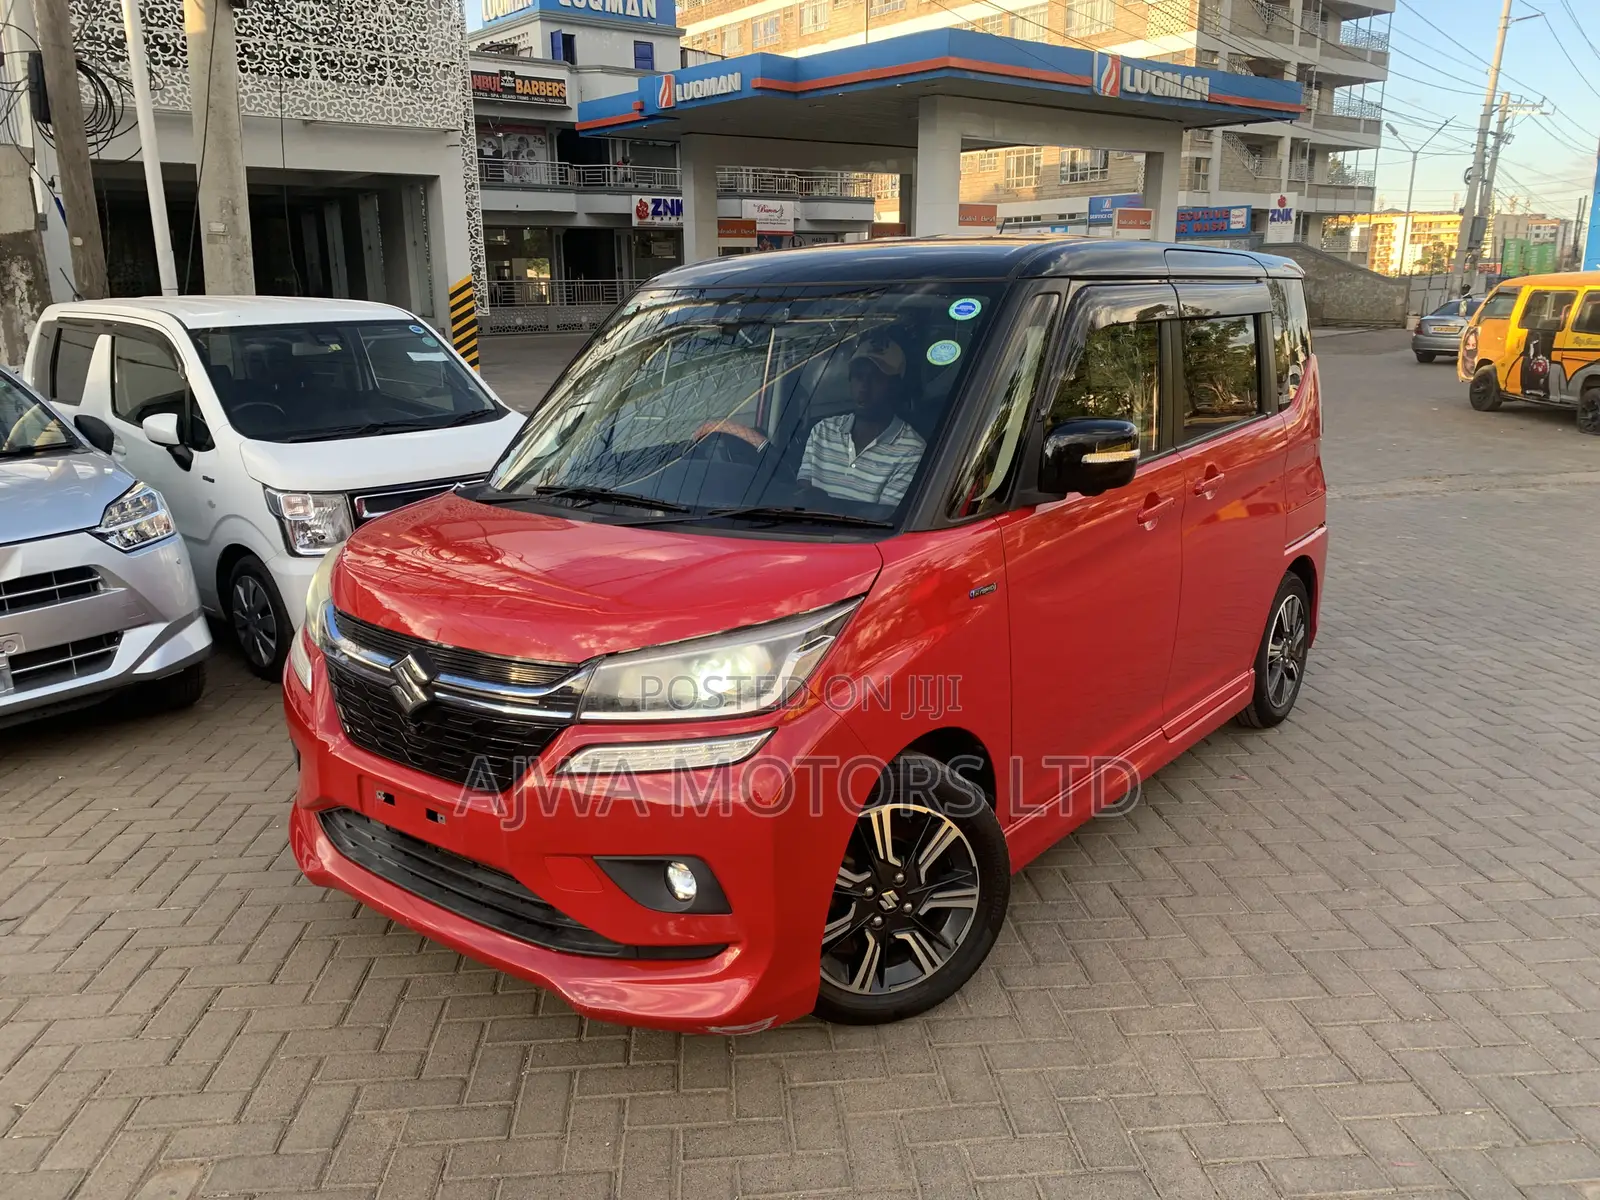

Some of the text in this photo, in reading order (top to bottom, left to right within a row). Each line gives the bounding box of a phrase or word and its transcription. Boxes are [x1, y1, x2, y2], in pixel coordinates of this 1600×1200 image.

[515, 78, 566, 97] BARBERS
[676, 72, 741, 102] LUQMAN
[1123, 66, 1209, 101] LUQMAN
[1269, 208, 1293, 222] ZNK
[1193, 221, 1227, 233] WASH
